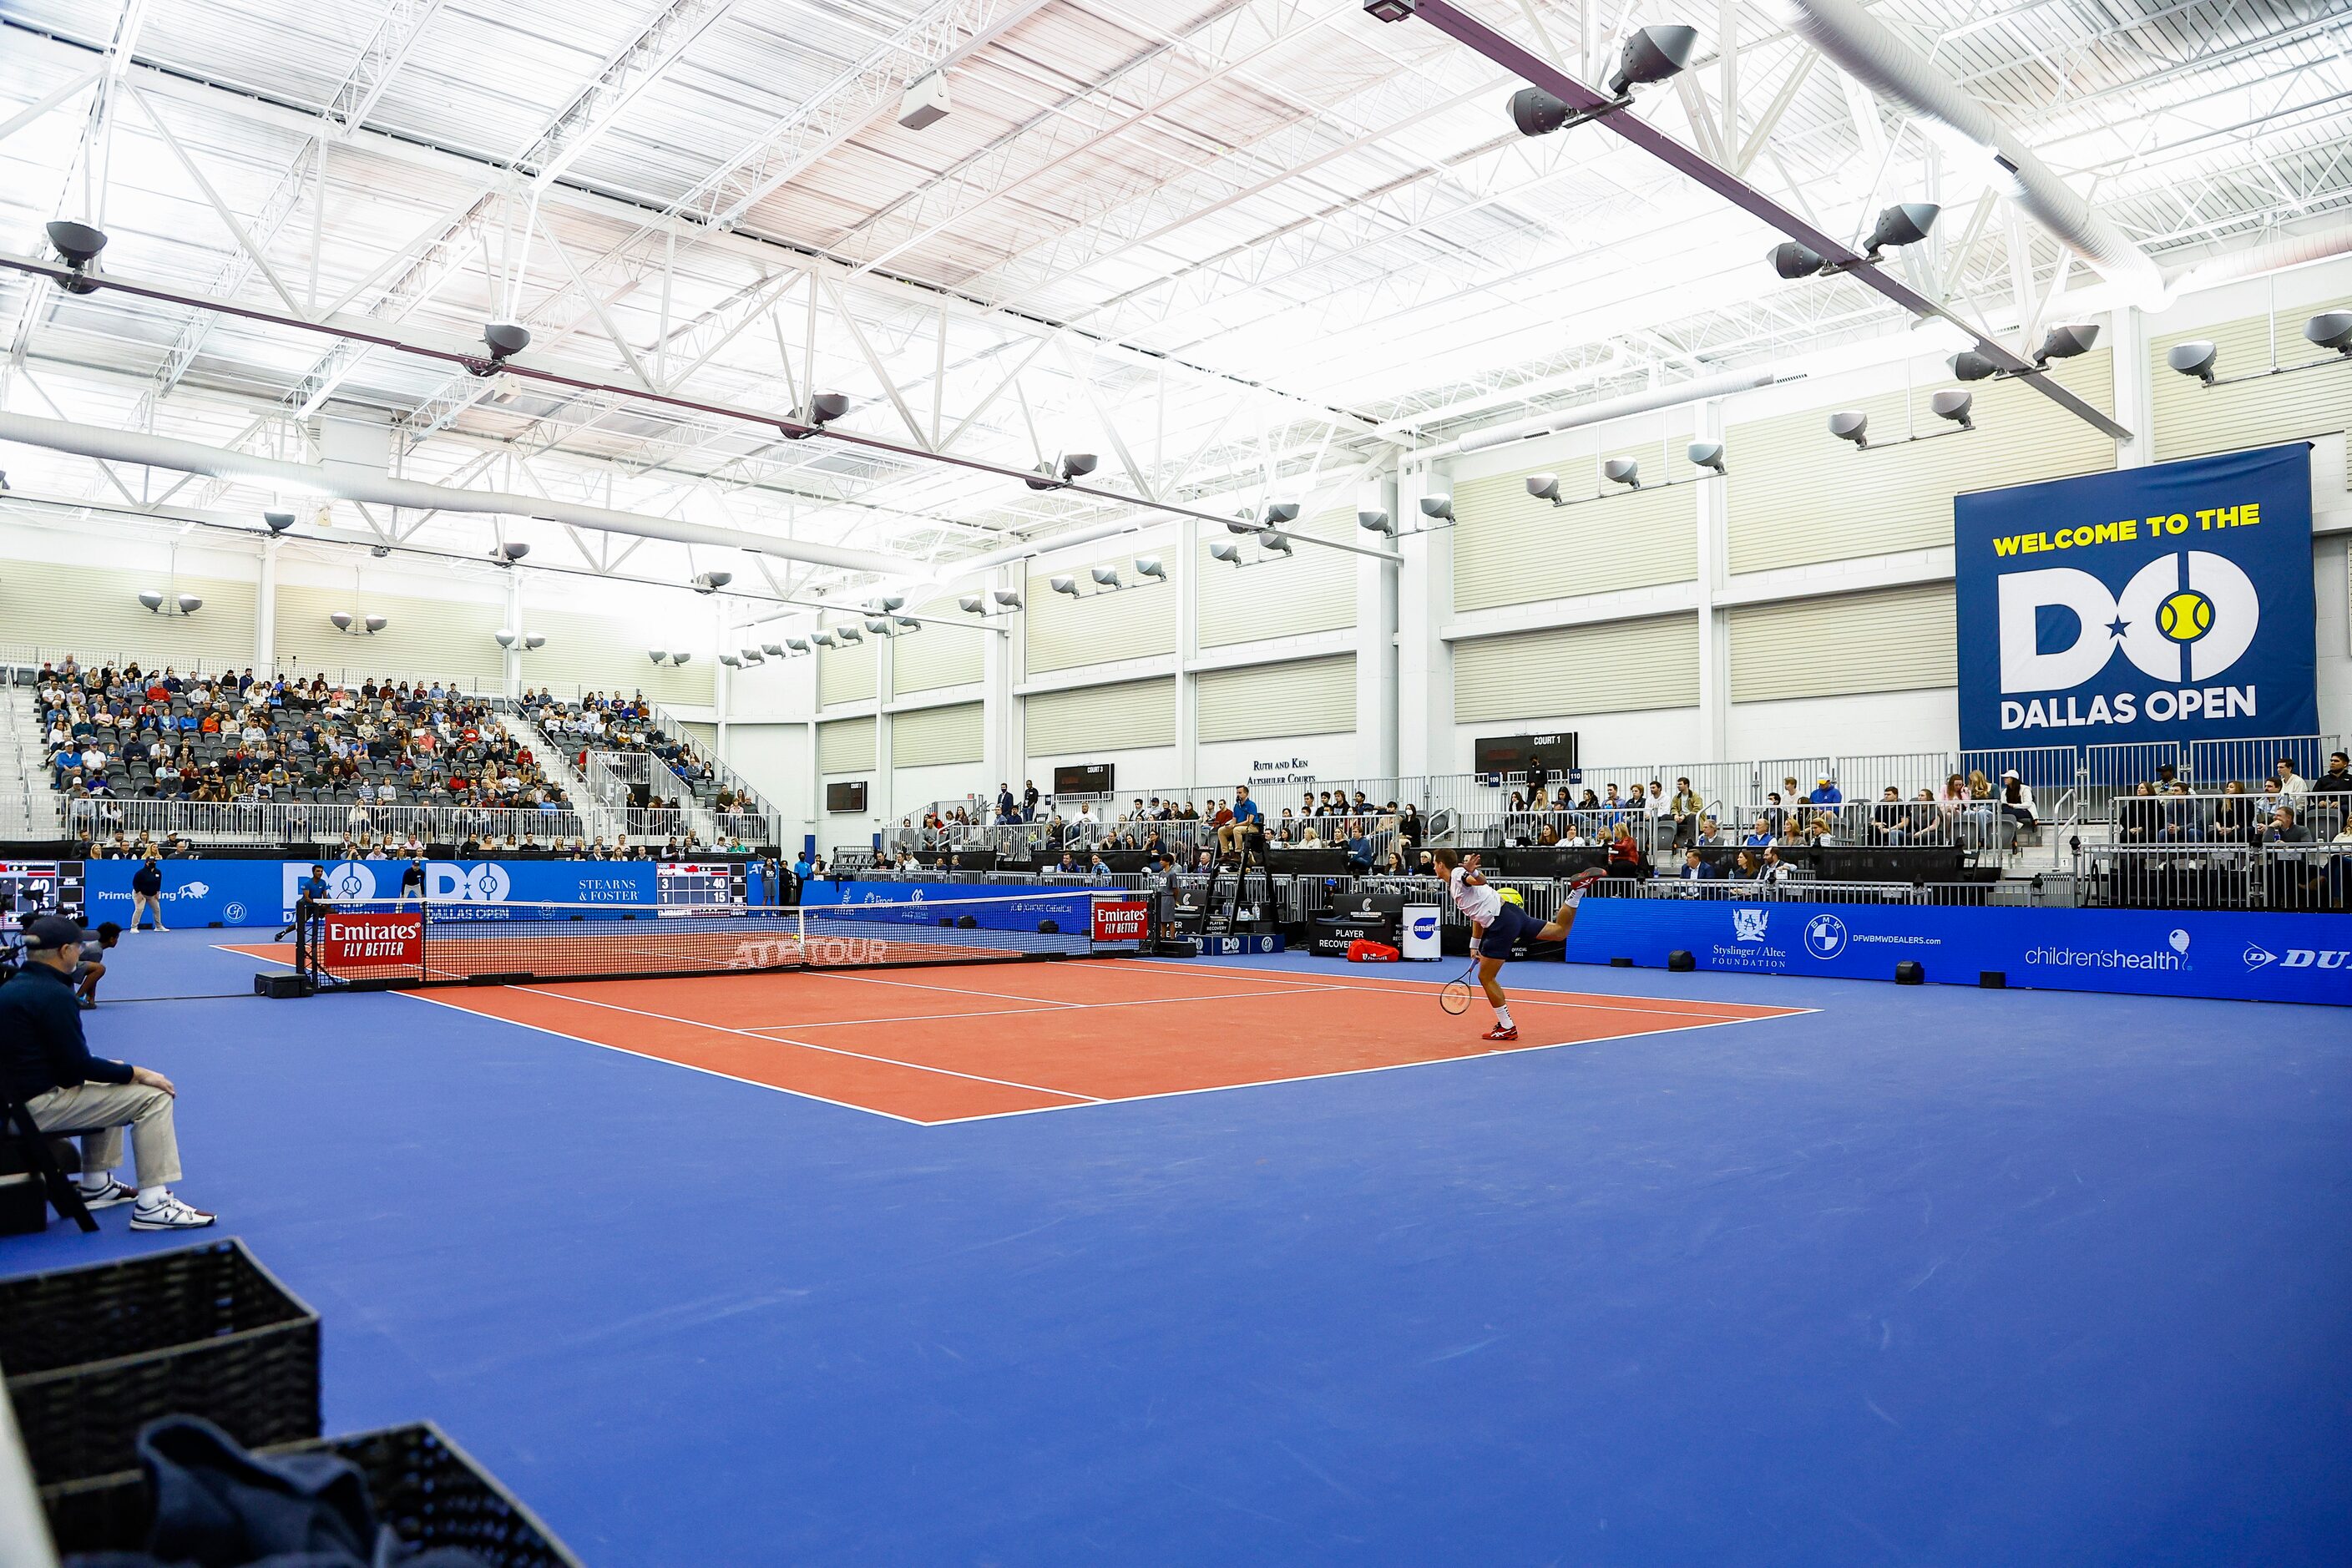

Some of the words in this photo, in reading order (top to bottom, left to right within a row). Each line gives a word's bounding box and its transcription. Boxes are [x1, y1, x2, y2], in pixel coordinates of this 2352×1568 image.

[1993, 519, 2137, 557] WELCOME
[2146, 513, 2189, 537] TO
[2195, 503, 2260, 530] THE
[2000, 692, 2137, 730] DALLAS
[2145, 685, 2256, 722] OPEN
[1534, 736, 1555, 745] COURT
[1556, 736, 1561, 744] 1
[748, 863, 763, 874] AT
[579, 879, 636, 890] STEARNS
[662, 878, 669, 889] 3
[713, 878, 726, 889] 40
[579, 891, 587, 901] &
[590, 891, 640, 901] FOSTER
[662, 893, 668, 903] 1
[714, 892, 726, 903] 15
[1105, 923, 1116, 934] FLY
[1117, 922, 1138, 933] BETTER
[1810, 917, 1842, 929] BMW
[1335, 928, 1364, 938] PLAYER
[1853, 934, 1941, 945] DFWBMWDEALERS.com
[343, 943, 362, 958] FLY
[365, 942, 404, 957] BETTER
[1713, 944, 1755, 959] Styslinger
[1763, 947, 1786, 957] Altec
[1712, 958, 1786, 968] FOUNDATION
[2279, 949, 2352, 969] DU
